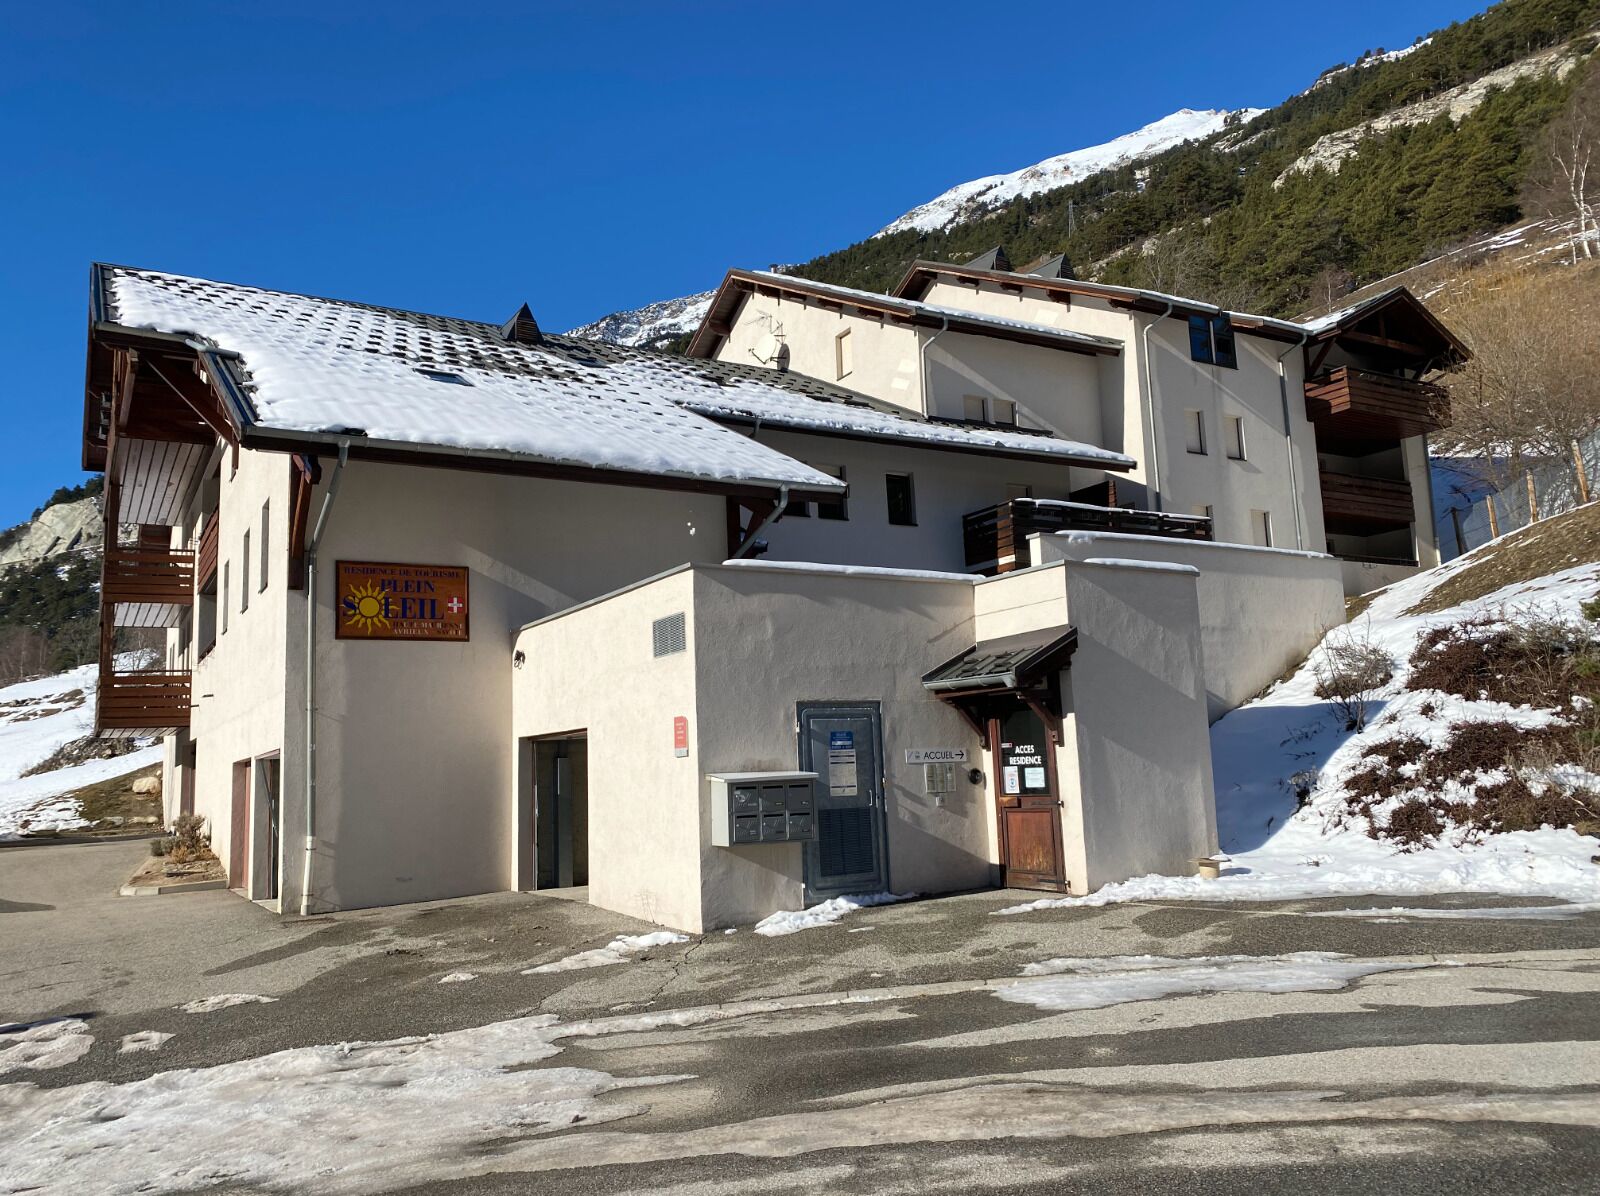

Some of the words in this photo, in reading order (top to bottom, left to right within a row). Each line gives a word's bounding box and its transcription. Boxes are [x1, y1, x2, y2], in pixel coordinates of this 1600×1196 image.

[400, 568, 412, 577] DE
[380, 578, 436, 593] PLEIN
[1014, 745, 1035, 754] ACCES
[923, 751, 954, 760] ACCUEIL
[1009, 756, 1042, 765] RESIDENCE
